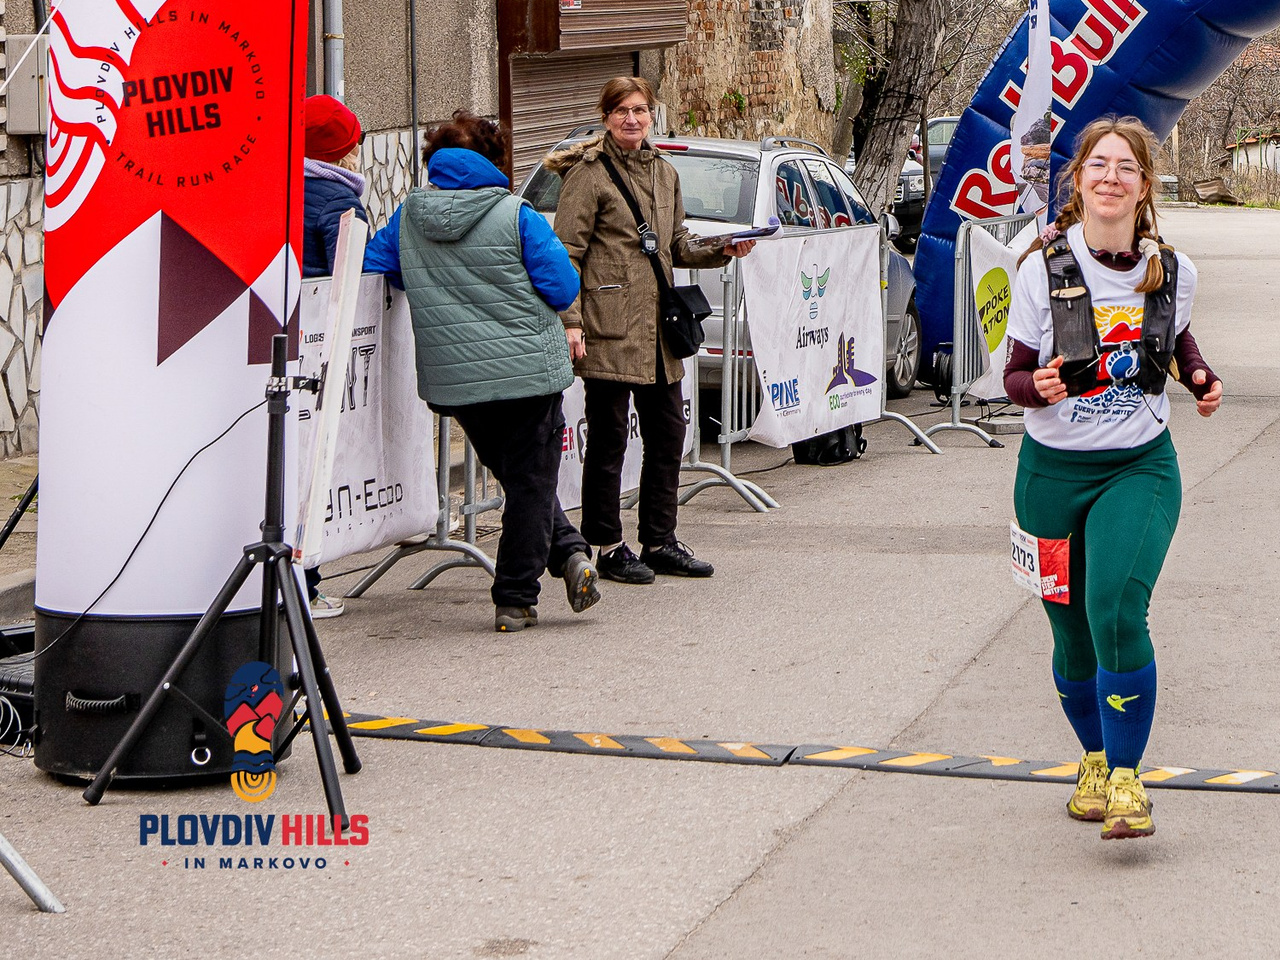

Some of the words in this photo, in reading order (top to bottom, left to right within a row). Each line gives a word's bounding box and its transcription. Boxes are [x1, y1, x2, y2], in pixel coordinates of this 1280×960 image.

[95, 42, 121, 123] PLOVDIV
[124, 10, 178, 40] HILLS
[190, 10, 209, 24] IN
[218, 20, 265, 100] MARKOVO
[121, 66, 233, 107] PLOVDIV
[146, 102, 221, 138] HILLS
[115, 151, 164, 186] TRAIL
[177, 171, 214, 188] RUN
[222, 133, 257, 174] RACE
[795, 326, 829, 349] Airways
[767, 378, 800, 409] PINE
[1073, 404, 1095, 415] EVERY
[1012, 542, 1035, 573] 2173
